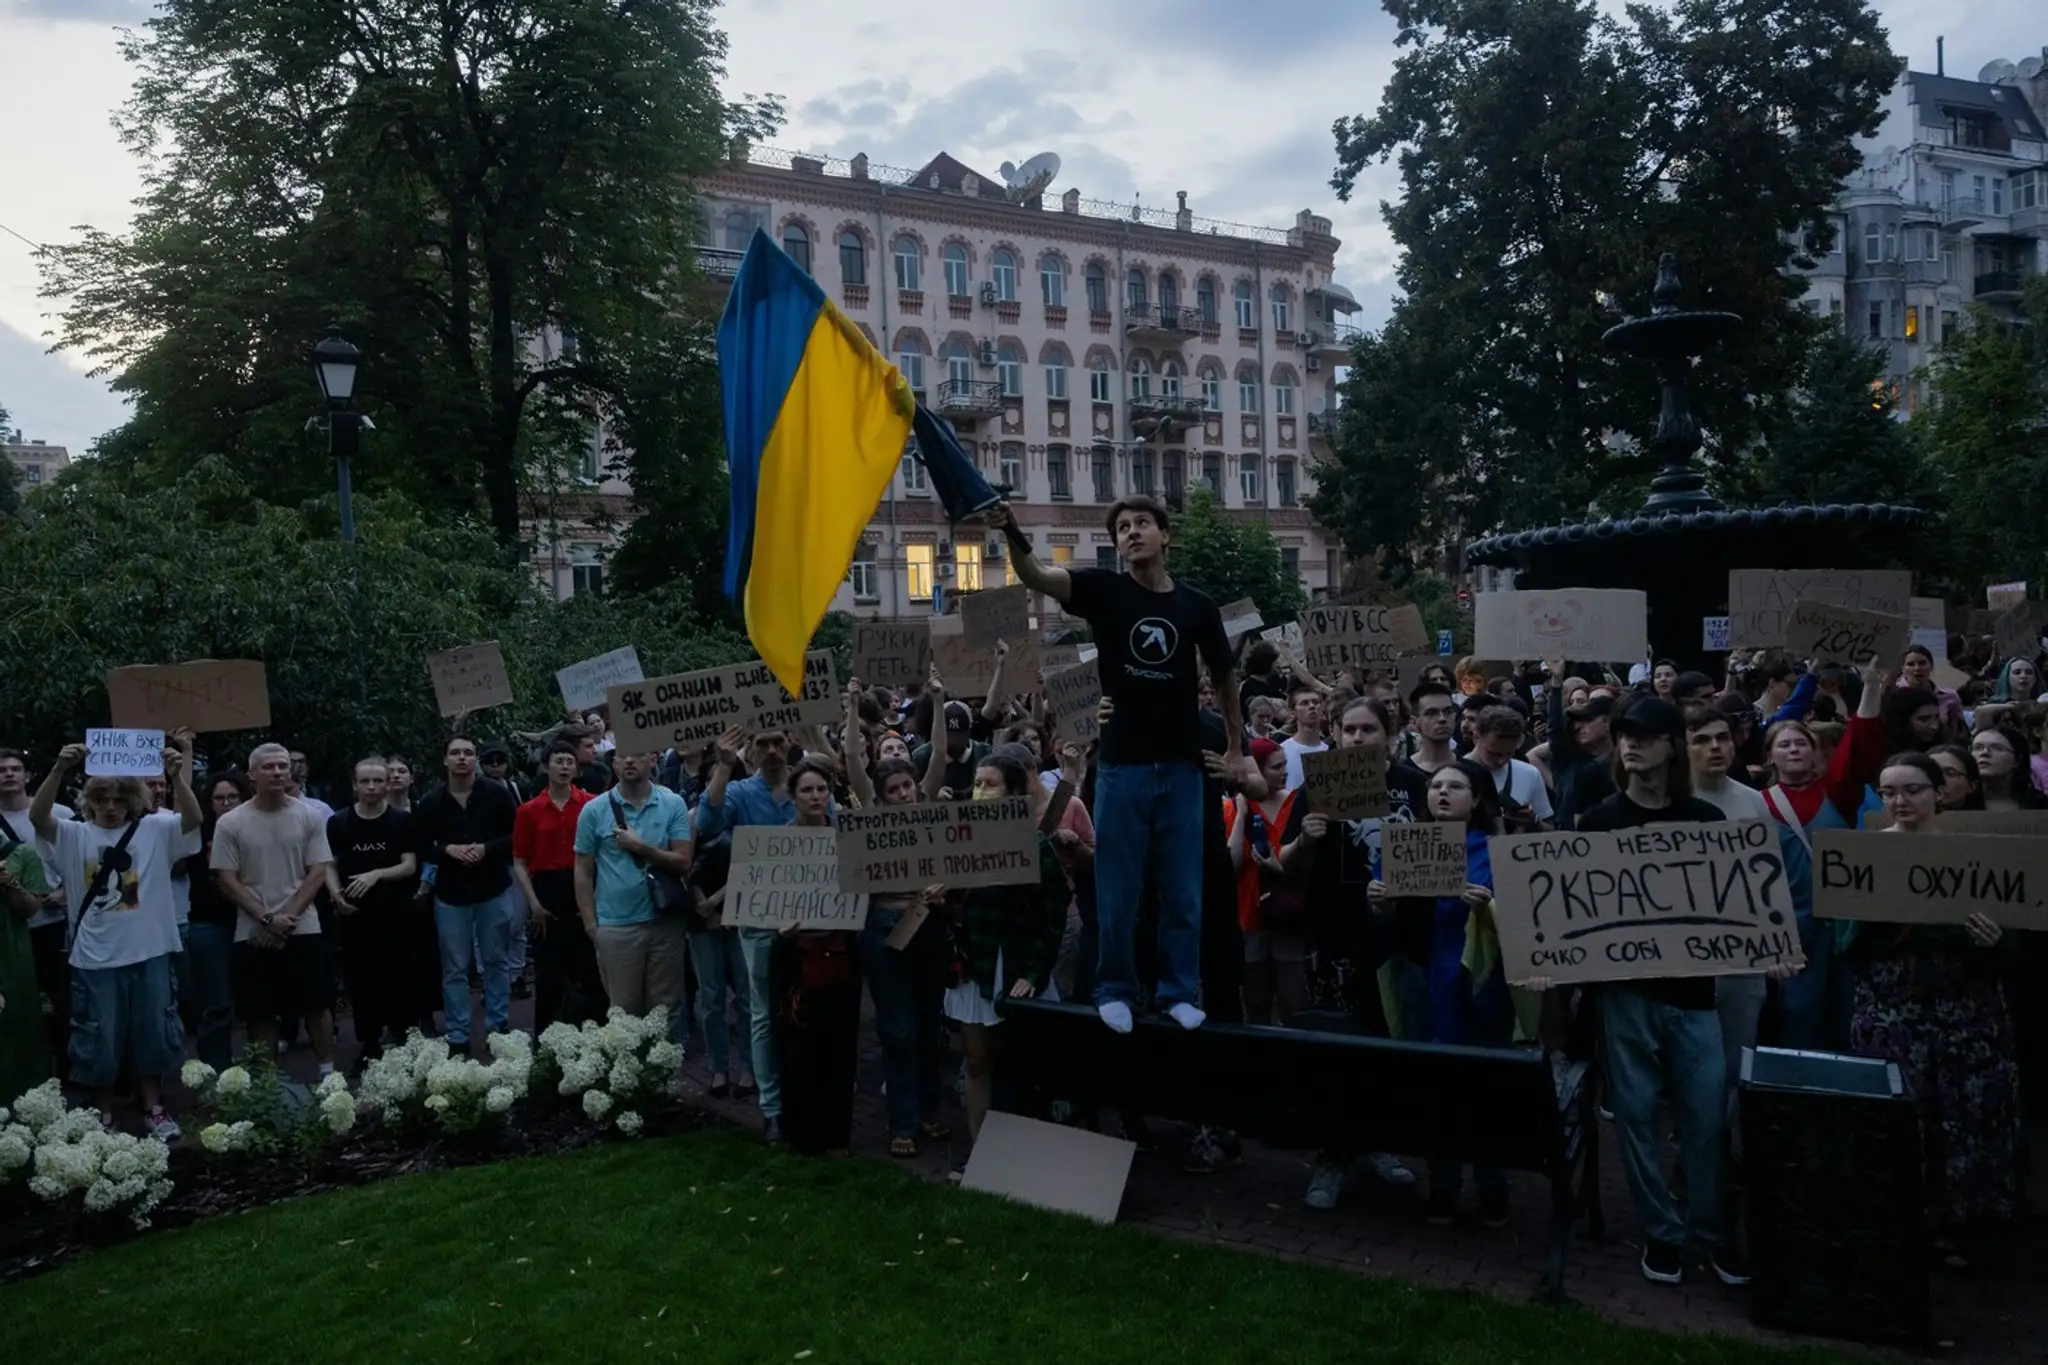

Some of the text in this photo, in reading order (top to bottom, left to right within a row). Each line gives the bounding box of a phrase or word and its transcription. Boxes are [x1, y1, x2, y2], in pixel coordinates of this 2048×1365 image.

[1300, 610, 1347, 636] ХОЧУ
[1732, 609, 1786, 641] СИСТ
[858, 628, 915, 653] РУКИ
[1812, 627, 1880, 663] 2013
[621, 690, 646, 713] ЯК
[656, 677, 722, 704] ОДНИМ
[1051, 668, 1098, 698] ЯНИК
[634, 679, 830, 730] ОПИНИЛИСЬ В 213?
[91, 731, 161, 750] ЯНИК ВЖЕ
[838, 801, 1030, 832] РЕТРОГРАДНИЙ МЕРКУРІЙ
[747, 836, 838, 858] У БОРОТЬ
[945, 824, 973, 843] ОП
[1511, 823, 1767, 862] СТАЛО НЕЗРУЧНО
[742, 864, 764, 886] ЗА
[918, 857, 936, 877] НЕ
[944, 850, 1030, 875] ПРОКАТИТЬ
[1531, 931, 1793, 967] ОЧКО СОБІ ВКРАДИ
